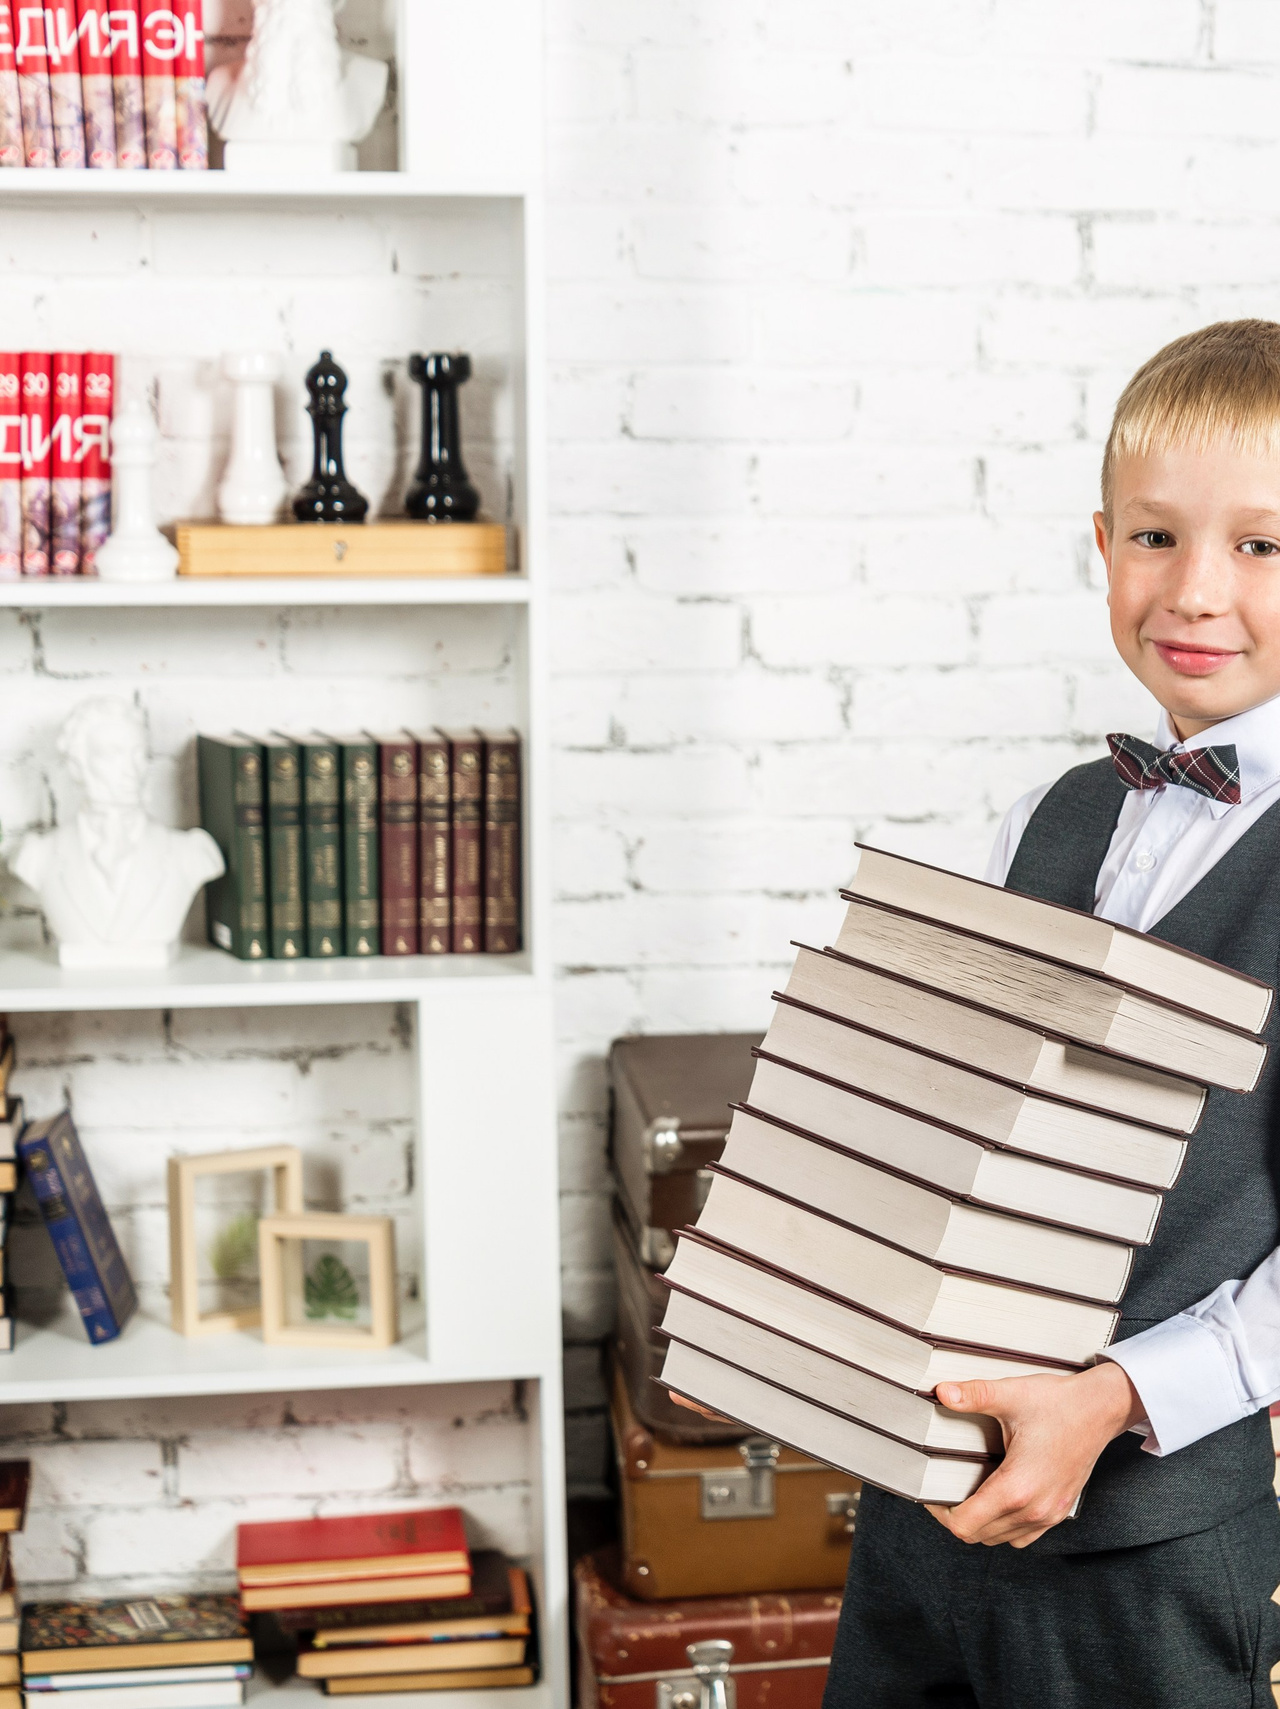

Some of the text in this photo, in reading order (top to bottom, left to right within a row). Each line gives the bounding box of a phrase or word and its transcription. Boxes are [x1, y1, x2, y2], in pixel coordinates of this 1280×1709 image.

[23, 372, 50, 398] 30
[56, 372, 79, 398] 31
[85, 373, 111, 398] 32
